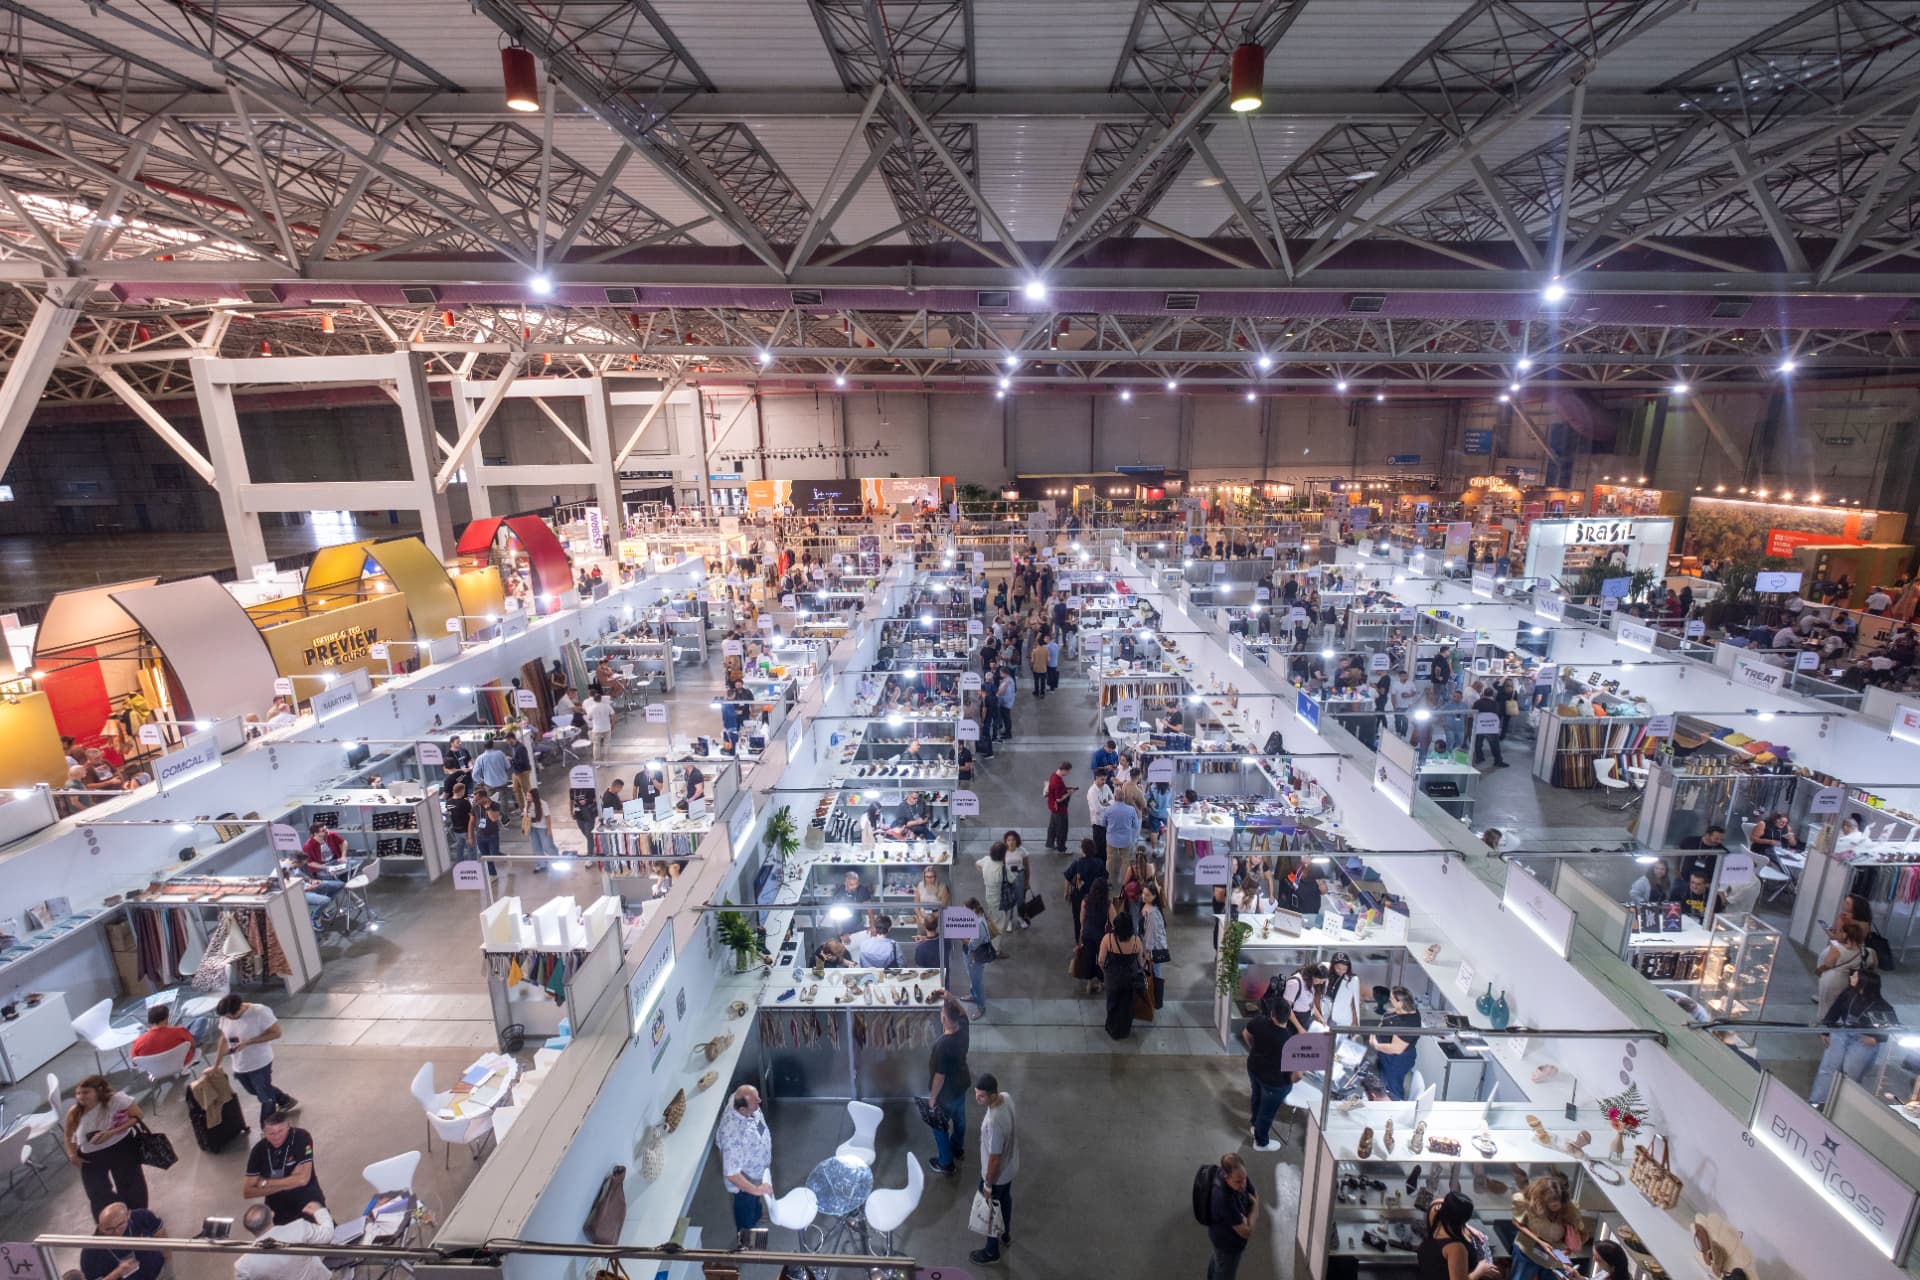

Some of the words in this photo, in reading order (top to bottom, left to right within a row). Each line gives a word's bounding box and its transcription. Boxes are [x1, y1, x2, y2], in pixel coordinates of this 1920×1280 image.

[304, 627, 379, 667] PREVIEW
[1744, 667, 1778, 685] TREAT
[161, 755, 204, 779] COMCAL
[1742, 1131, 1755, 1148] 60
